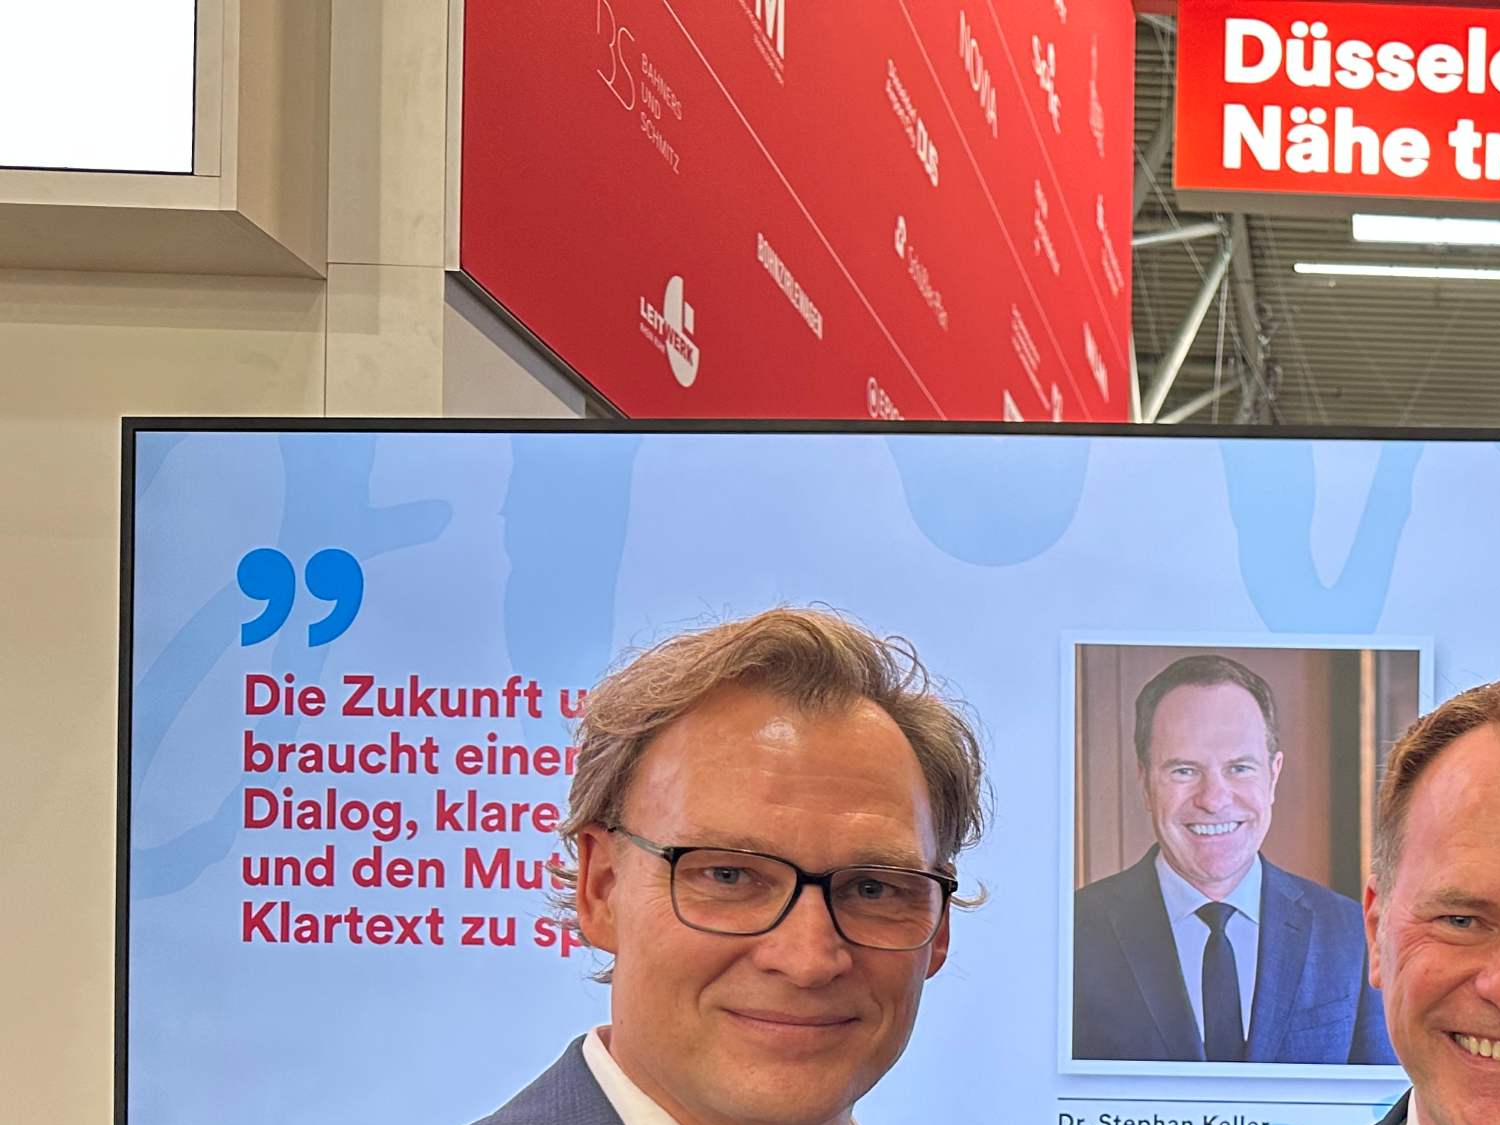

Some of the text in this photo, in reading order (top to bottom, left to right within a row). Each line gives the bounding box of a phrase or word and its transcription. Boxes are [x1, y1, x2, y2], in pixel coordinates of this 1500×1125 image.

[641, 52, 683, 120] BAHNERS
[641, 82, 661, 119] UND
[641, 112, 679, 174] SCHMITZ
[1223, 104, 1430, 177] Nähe
[245, 673, 326, 717] Die
[342, 674, 542, 718] Zukunft
[243, 730, 439, 774] braucht
[244, 787, 559, 841] Dialog, klare
[242, 845, 567, 889] und den Mut
[242, 901, 444, 945] Klartext
[461, 916, 516, 946] zu
